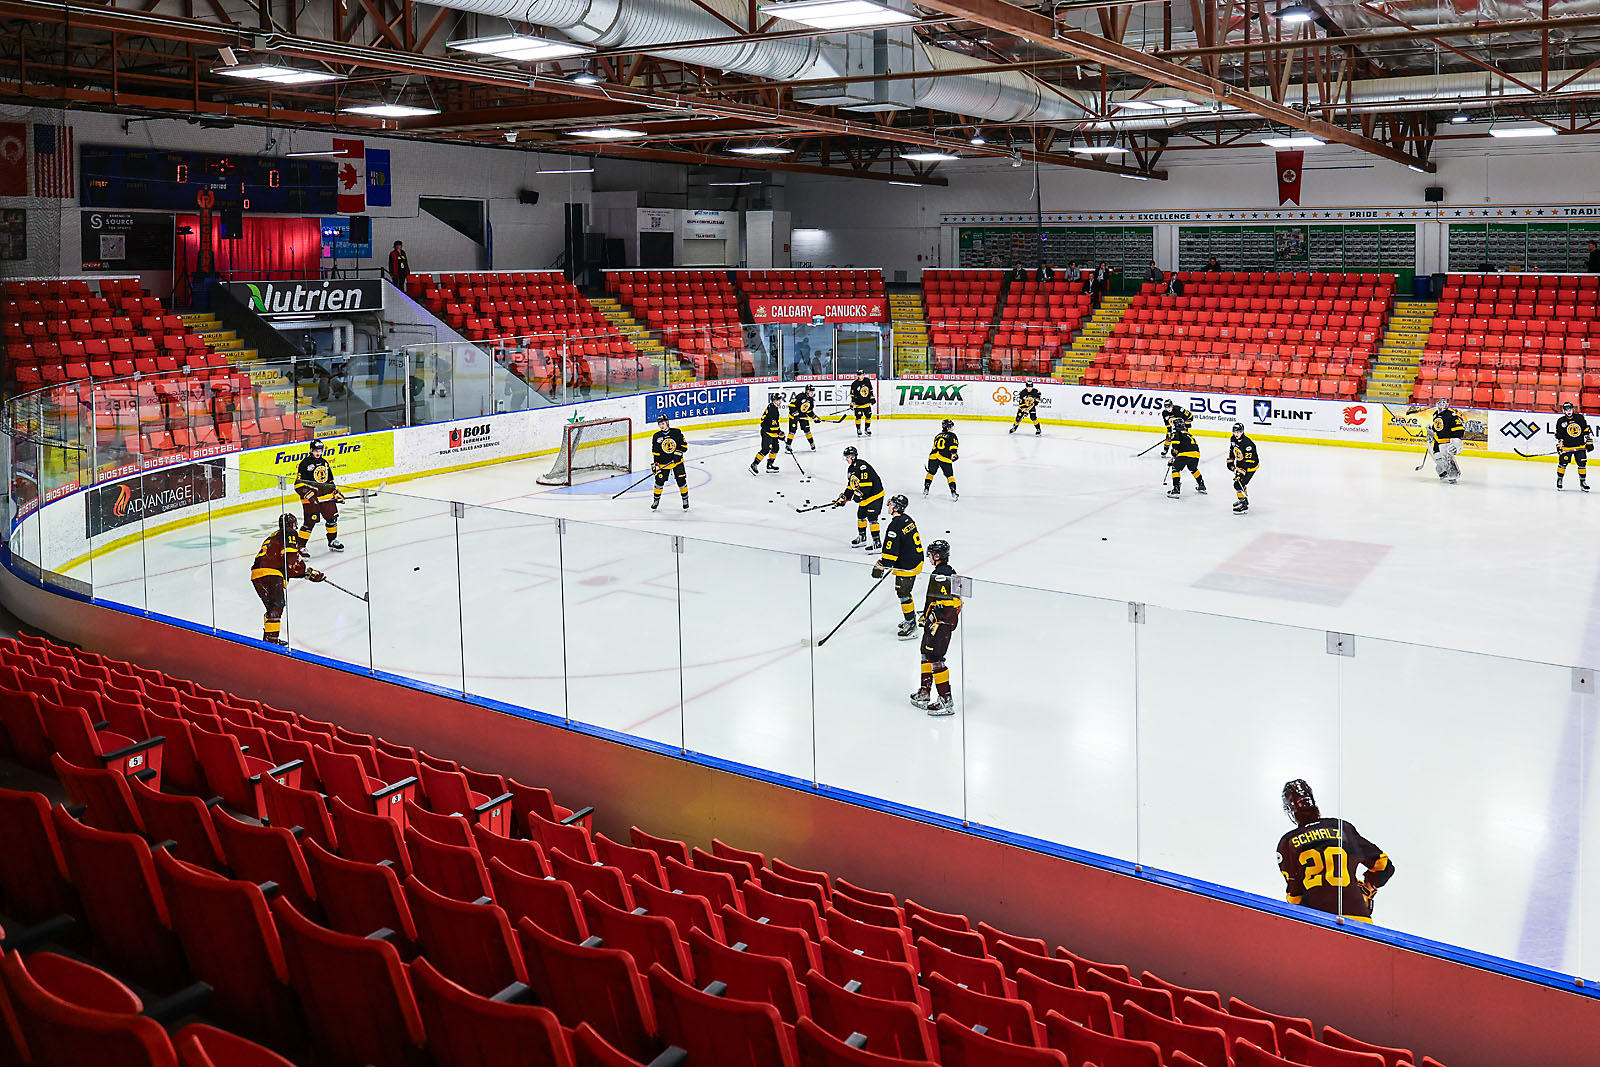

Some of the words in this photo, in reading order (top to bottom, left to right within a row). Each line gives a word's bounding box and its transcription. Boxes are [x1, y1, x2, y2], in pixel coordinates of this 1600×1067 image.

[177, 165, 188, 183] 0
[269, 170, 279, 188] 0
[247, 281, 363, 312] Nutrien
[771, 305, 813, 318] CALGARY
[825, 304, 867, 317] CANUCKS
[656, 388, 737, 410] BIRCHCLIFF
[896, 384, 967, 406] TRAXX
[1082, 393, 1163, 409] cenovus
[674, 407, 716, 418] ENERGY
[1190, 397, 1237, 415] BLG
[1273, 409, 1313, 421] FLINT
[463, 423, 491, 438] BOSS
[1339, 425, 1369, 433] Foundation
[193, 444, 239, 457] BIOSTEEL
[275, 447, 335, 465] Founin
[337, 442, 361, 455] Tire
[144, 453, 187, 469] BIOSTEEL
[99, 465, 139, 481] BIOSTEEL
[45, 483, 78, 502] BIOSTEEL
[127, 484, 192, 515] ADVANTAGE
[886, 540, 893, 549] 9
[912, 531, 924, 553] 9
[940, 585, 948, 595] 4
[1291, 828, 1343, 848] SCHMALZ
[1298, 846, 1351, 890] 20
